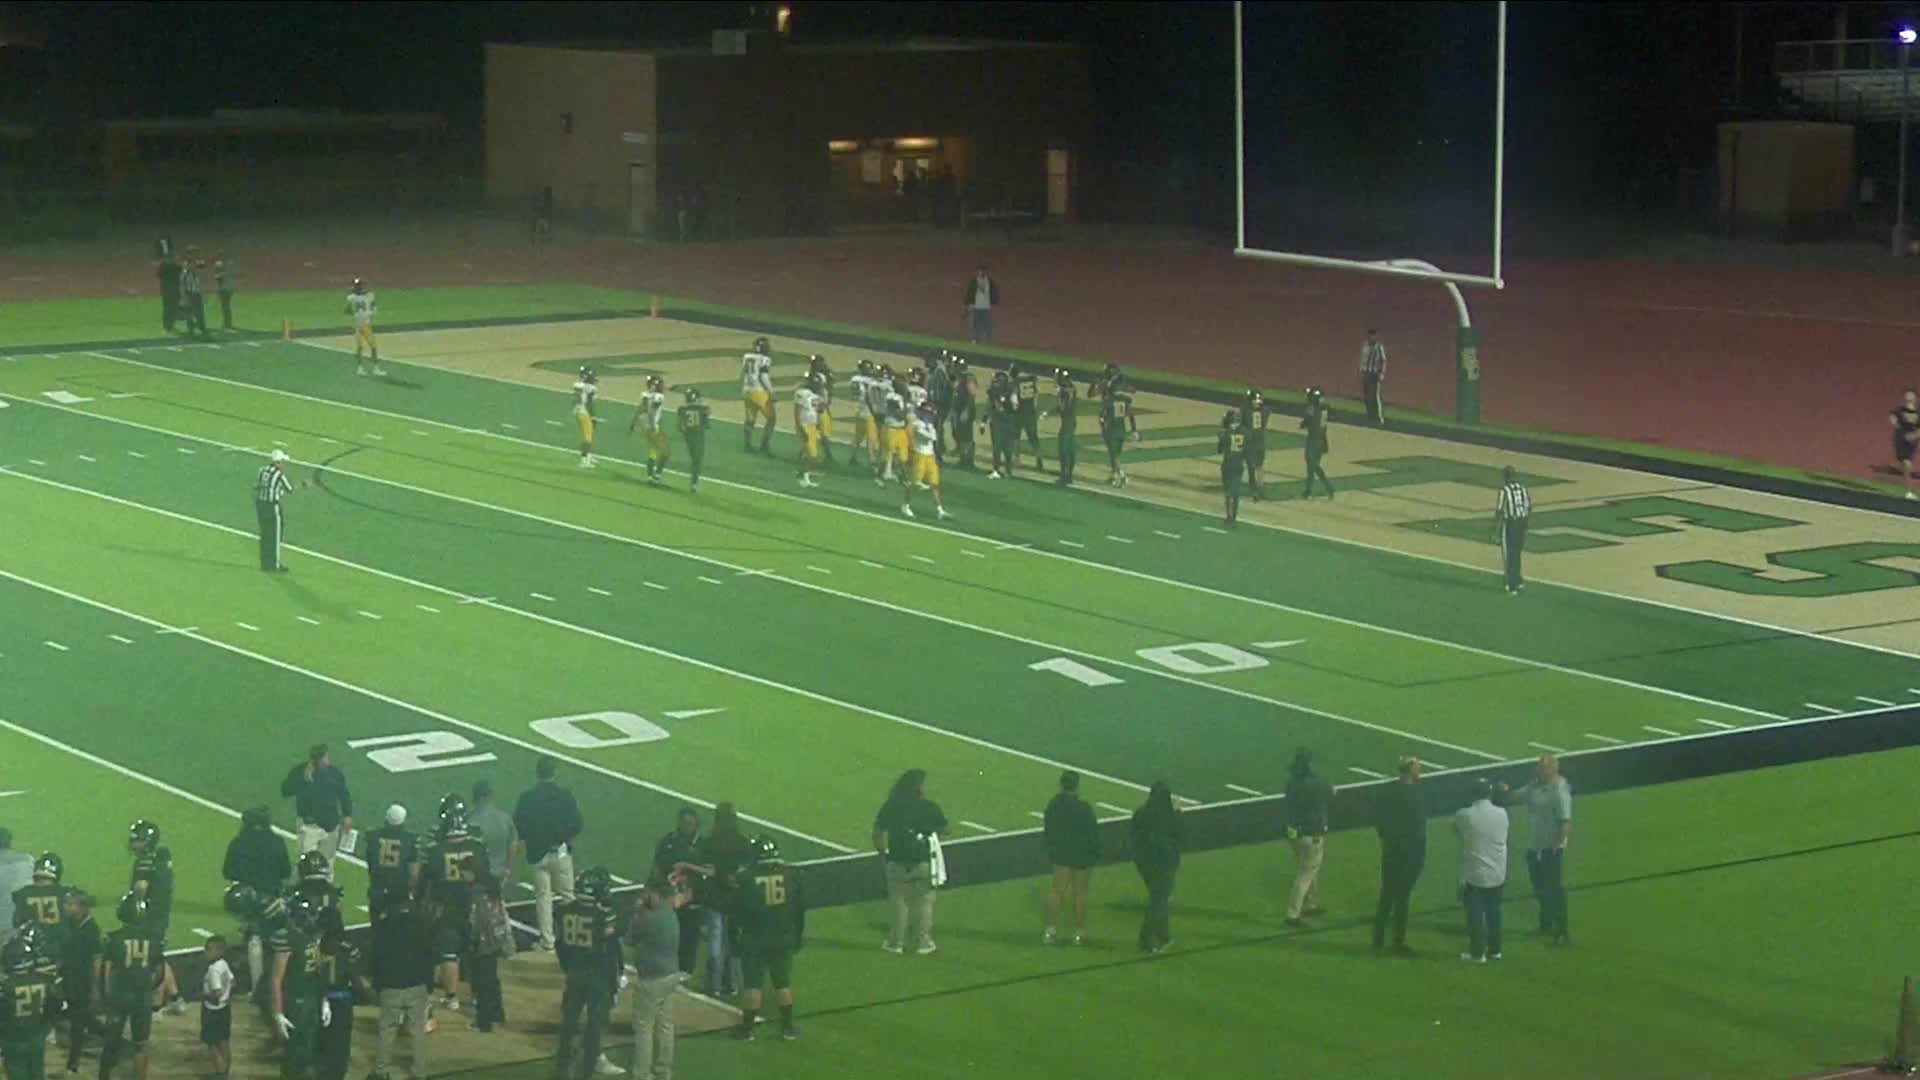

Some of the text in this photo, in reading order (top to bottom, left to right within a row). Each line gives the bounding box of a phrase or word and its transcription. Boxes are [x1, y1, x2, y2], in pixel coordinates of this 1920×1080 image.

[685, 410, 700, 427] 31
[378, 837, 402, 867] 15
[753, 874, 786, 906] 76
[27, 895, 61, 926] 73
[562, 912, 593, 950] 85
[122, 938, 151, 970] 14
[14, 983, 47, 1018] 27
